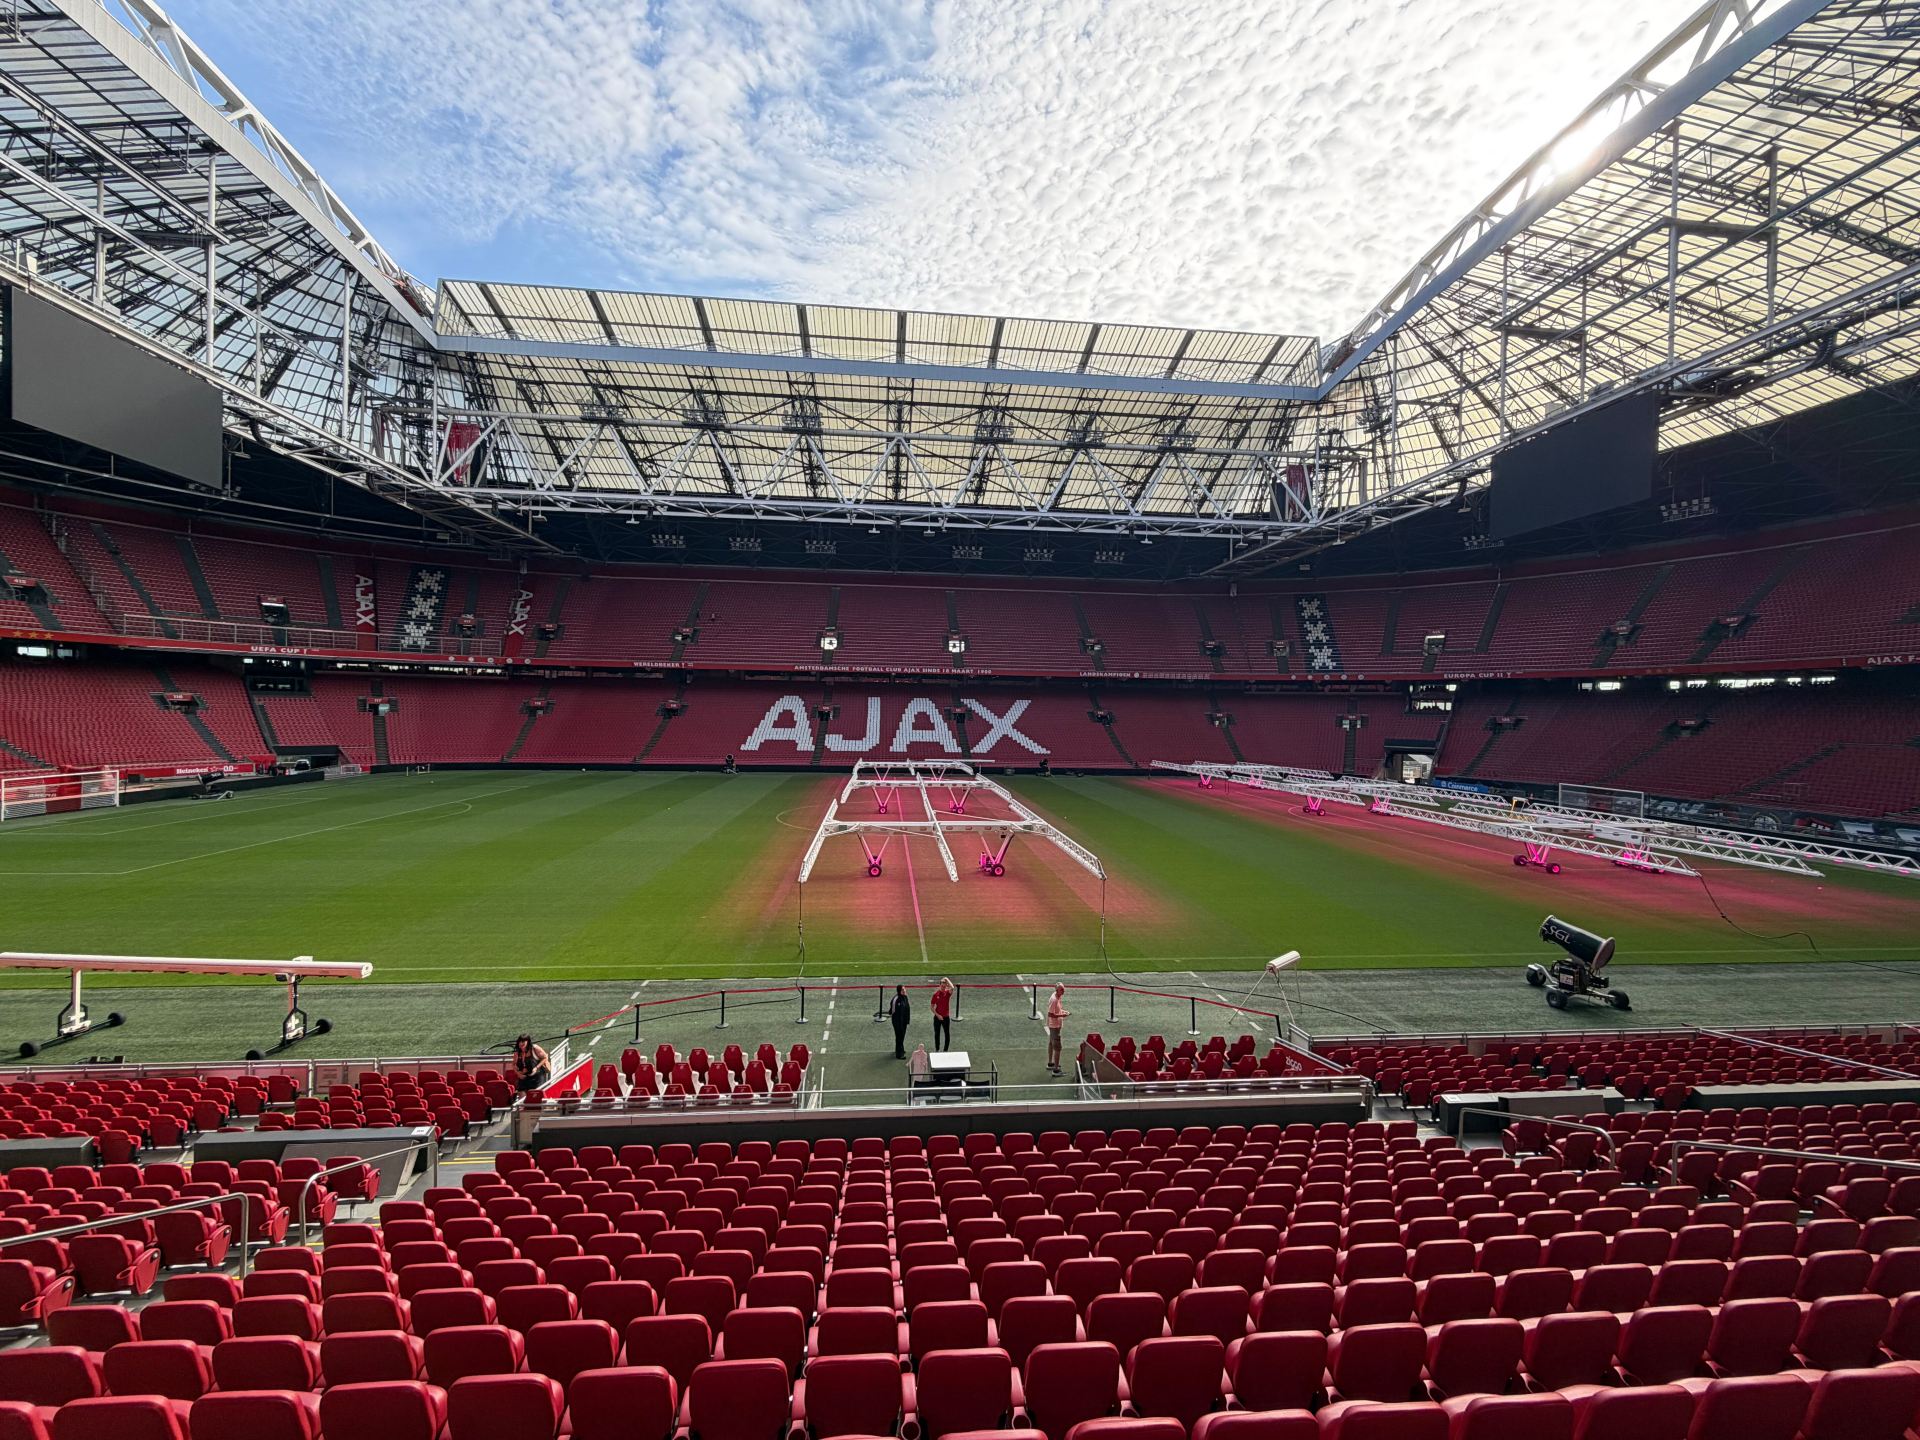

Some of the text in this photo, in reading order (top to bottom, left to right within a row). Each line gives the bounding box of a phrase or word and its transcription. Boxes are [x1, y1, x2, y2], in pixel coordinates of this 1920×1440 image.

[355, 574, 376, 627] AJAX
[508, 589, 533, 636] AJAX
[1867, 656, 1903, 665] AJAX
[740, 695, 1051, 755] AJAX
[176, 766, 209, 775] Heineken
[1447, 781, 1479, 792] Coinmerce
[1548, 925, 1572, 945] SGL
